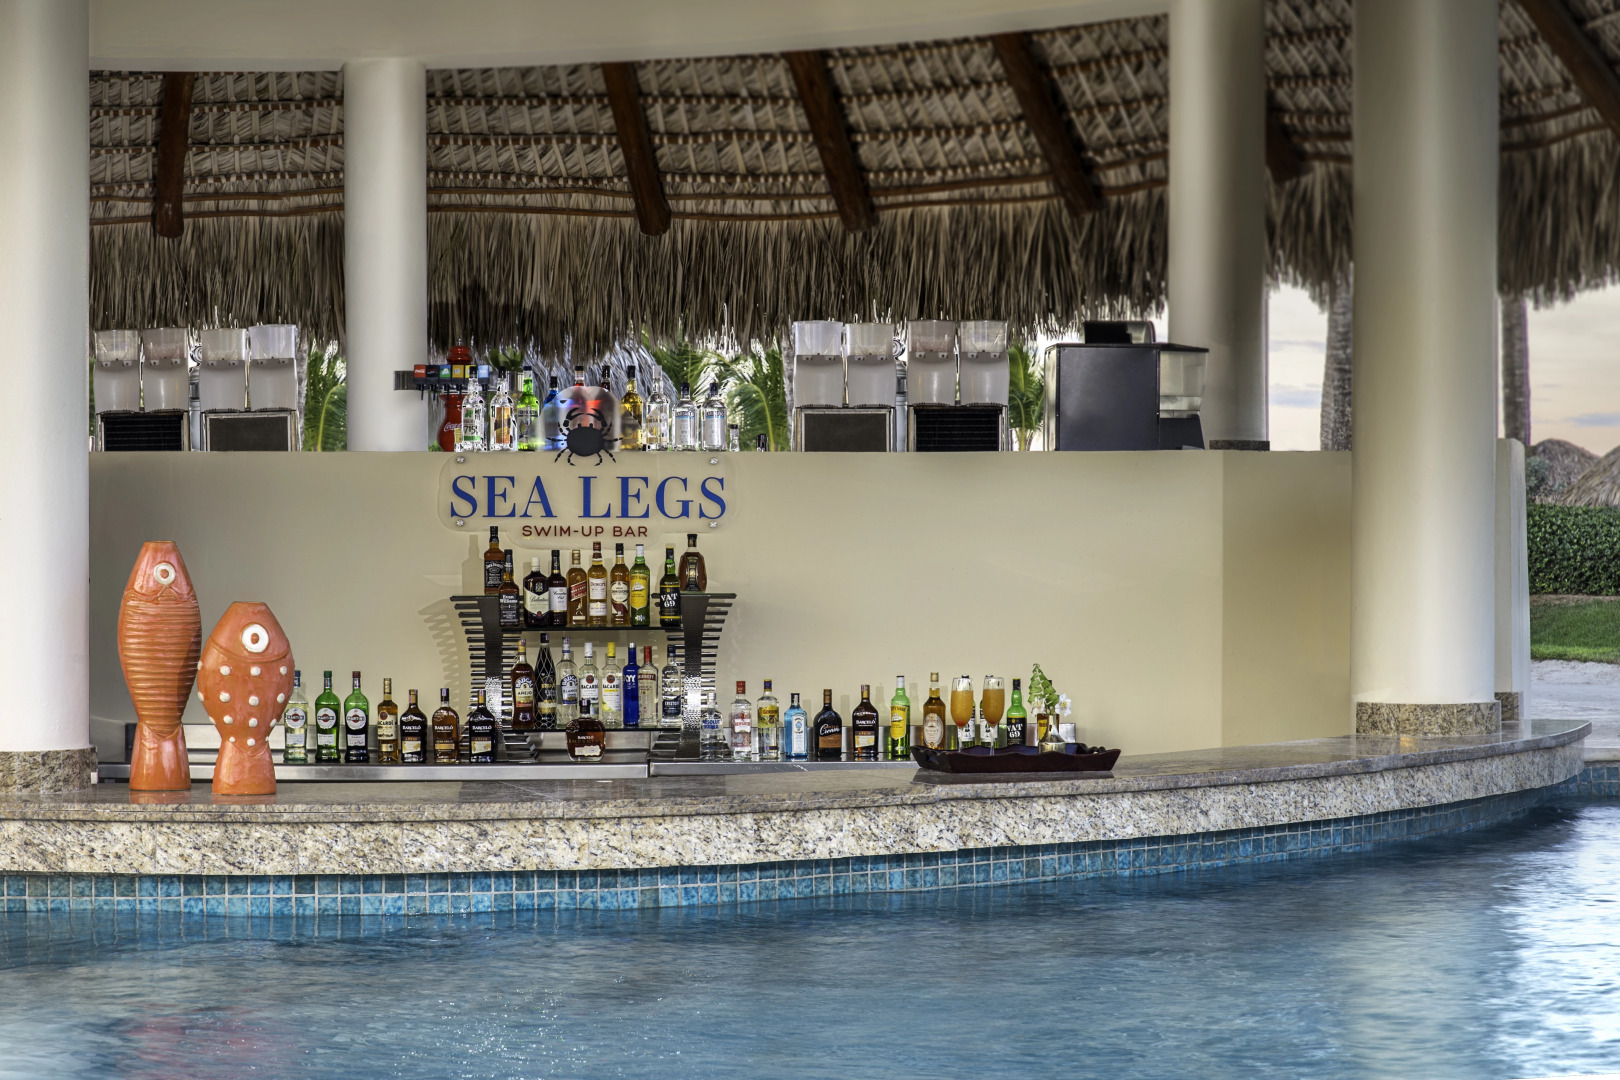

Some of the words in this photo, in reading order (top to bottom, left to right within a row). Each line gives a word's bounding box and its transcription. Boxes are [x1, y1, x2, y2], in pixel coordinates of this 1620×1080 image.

[450, 475, 558, 518] SEA
[578, 476, 726, 519] LEGS
[522, 525, 604, 537] SWIM-UP
[612, 526, 648, 537] BAR
[660, 592, 678, 600] VAT
